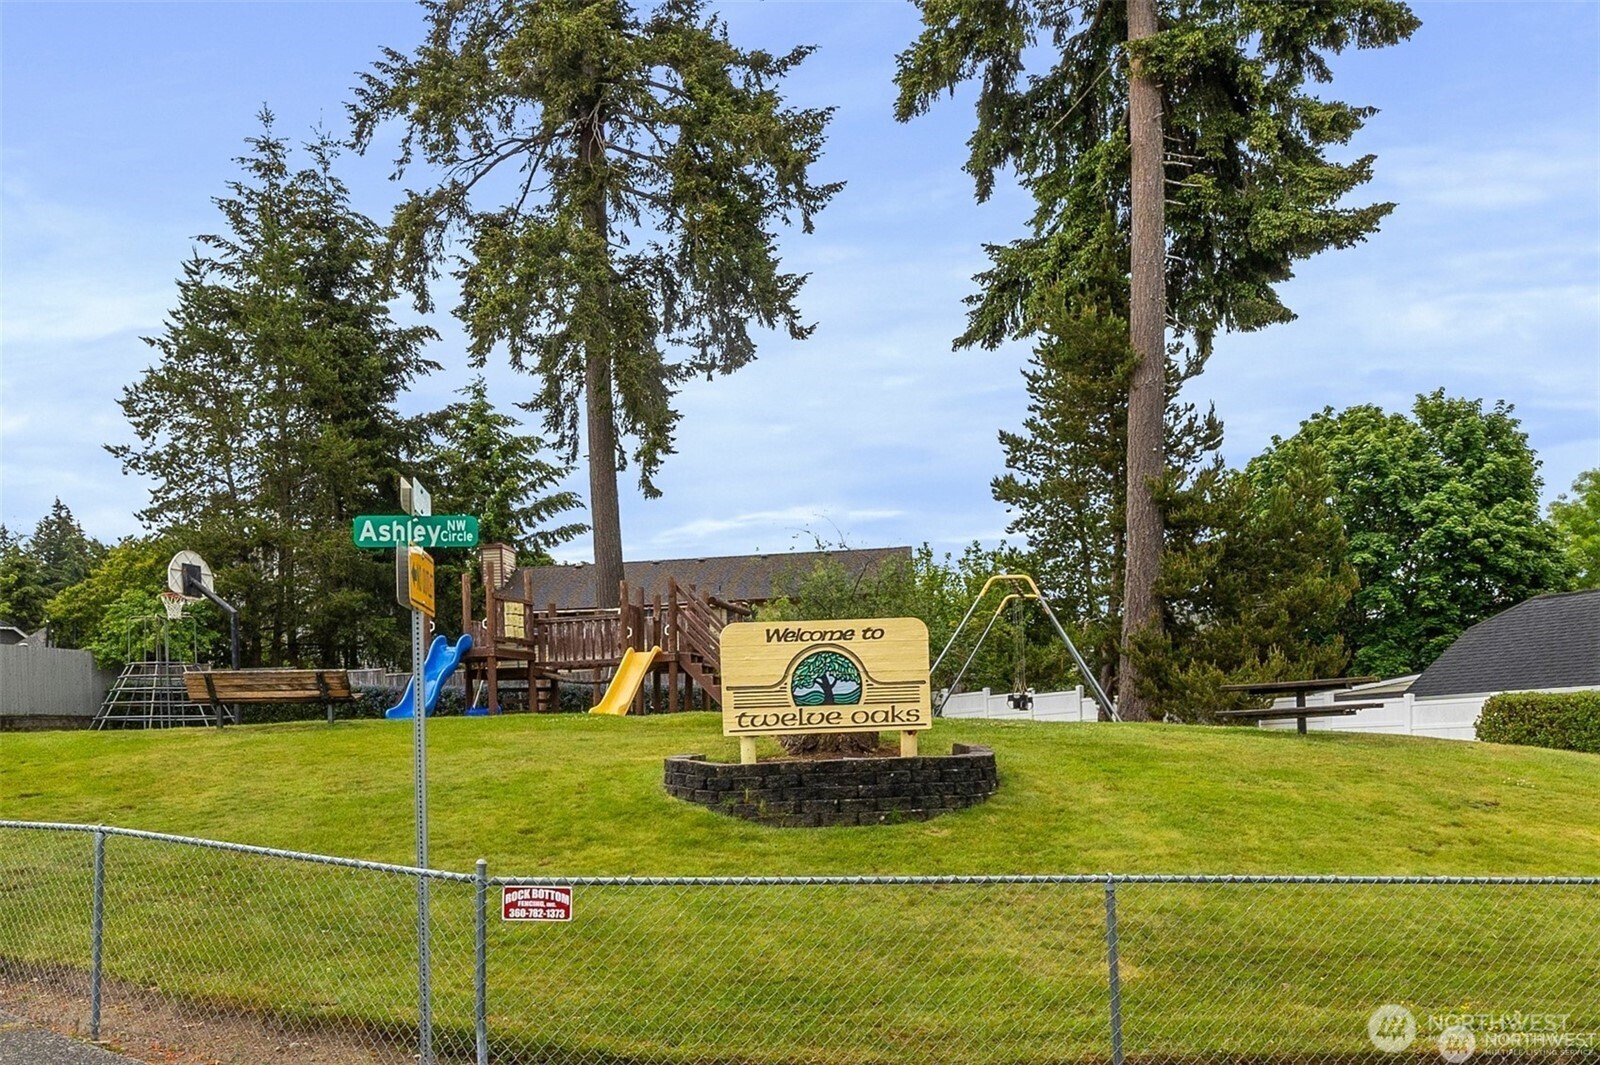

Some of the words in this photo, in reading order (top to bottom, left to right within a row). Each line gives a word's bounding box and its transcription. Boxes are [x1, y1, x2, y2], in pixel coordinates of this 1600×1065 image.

[359, 519, 441, 547] Ashley
[446, 519, 466, 531] NW
[440, 530, 474, 542] Circle
[765, 627, 855, 643] Welcome
[861, 627, 885, 640] to
[735, 707, 843, 728] twelve
[851, 705, 921, 724] oaks
[505, 888, 531, 905] ROCK
[531, 888, 570, 906] BOTTOM
[508, 908, 566, 919] 360-782-1373
